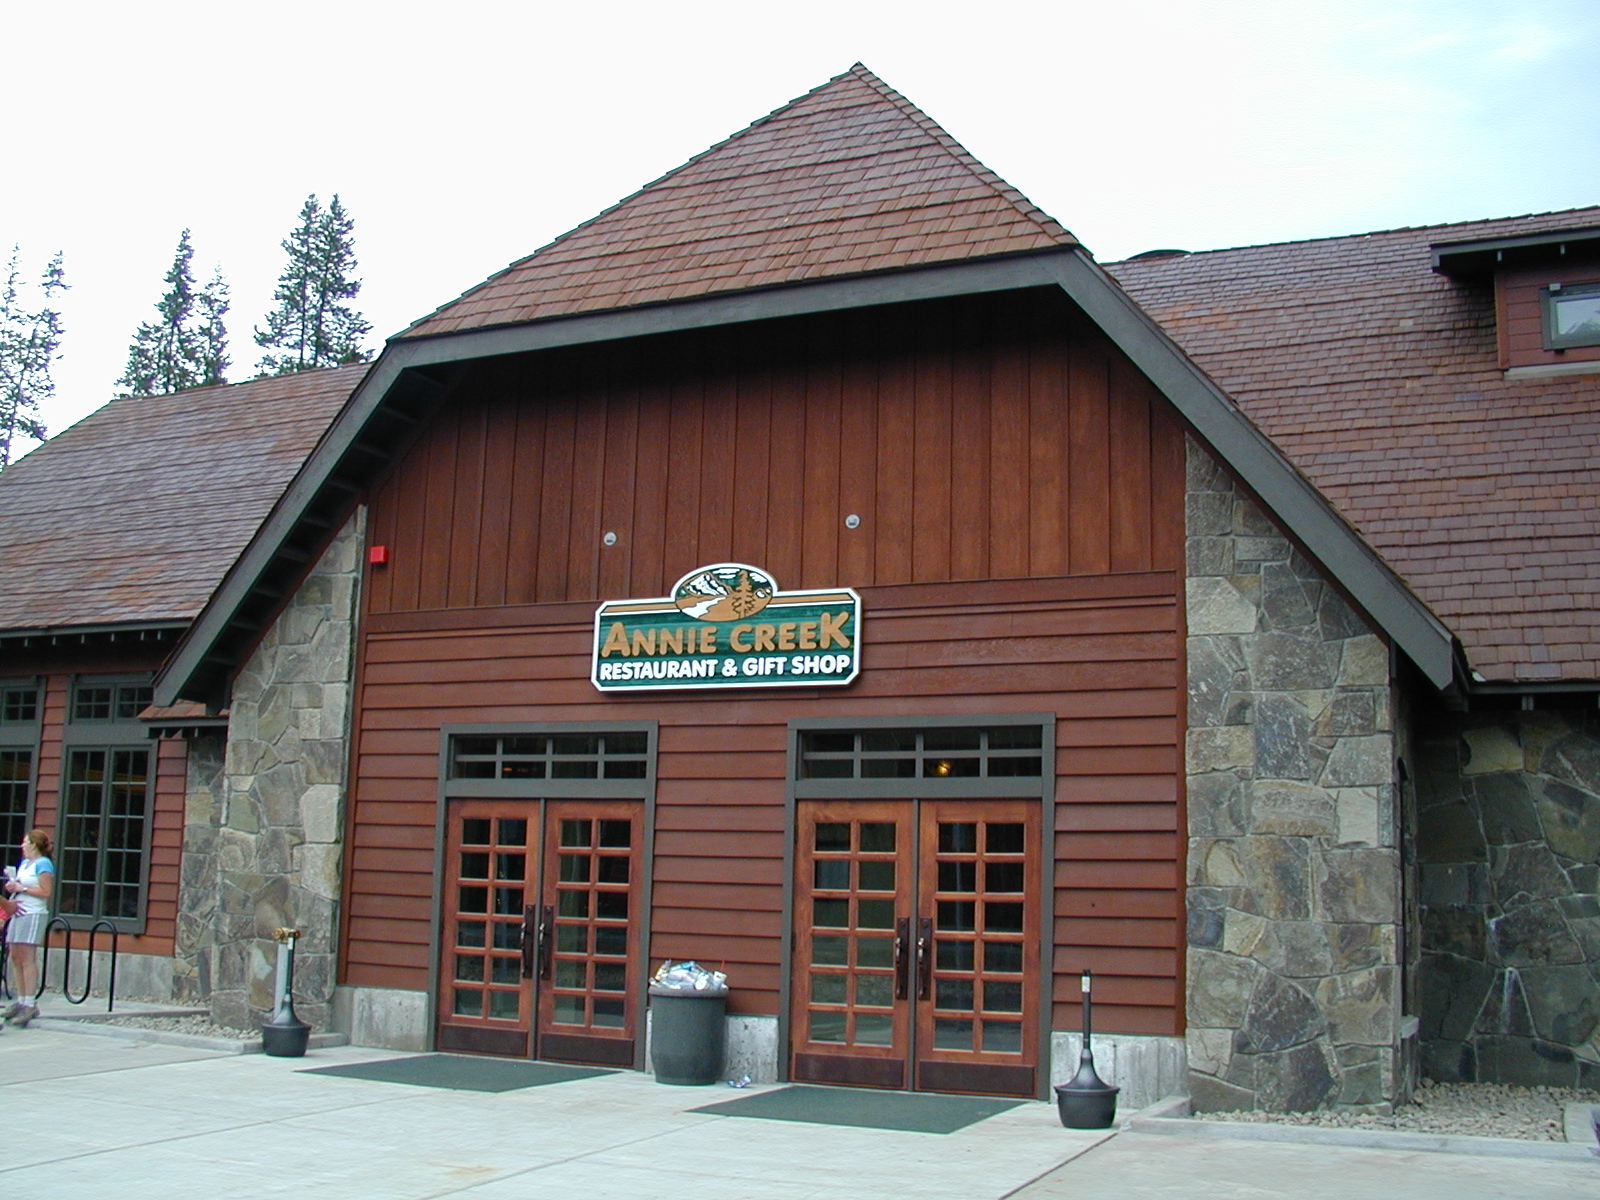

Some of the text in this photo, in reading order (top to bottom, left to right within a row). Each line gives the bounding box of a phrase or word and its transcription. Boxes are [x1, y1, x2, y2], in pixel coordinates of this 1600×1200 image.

[601, 612, 850, 658] ANNIE CREEK
[600, 655, 850, 680] RESTAURANT & GIFT SHOP
